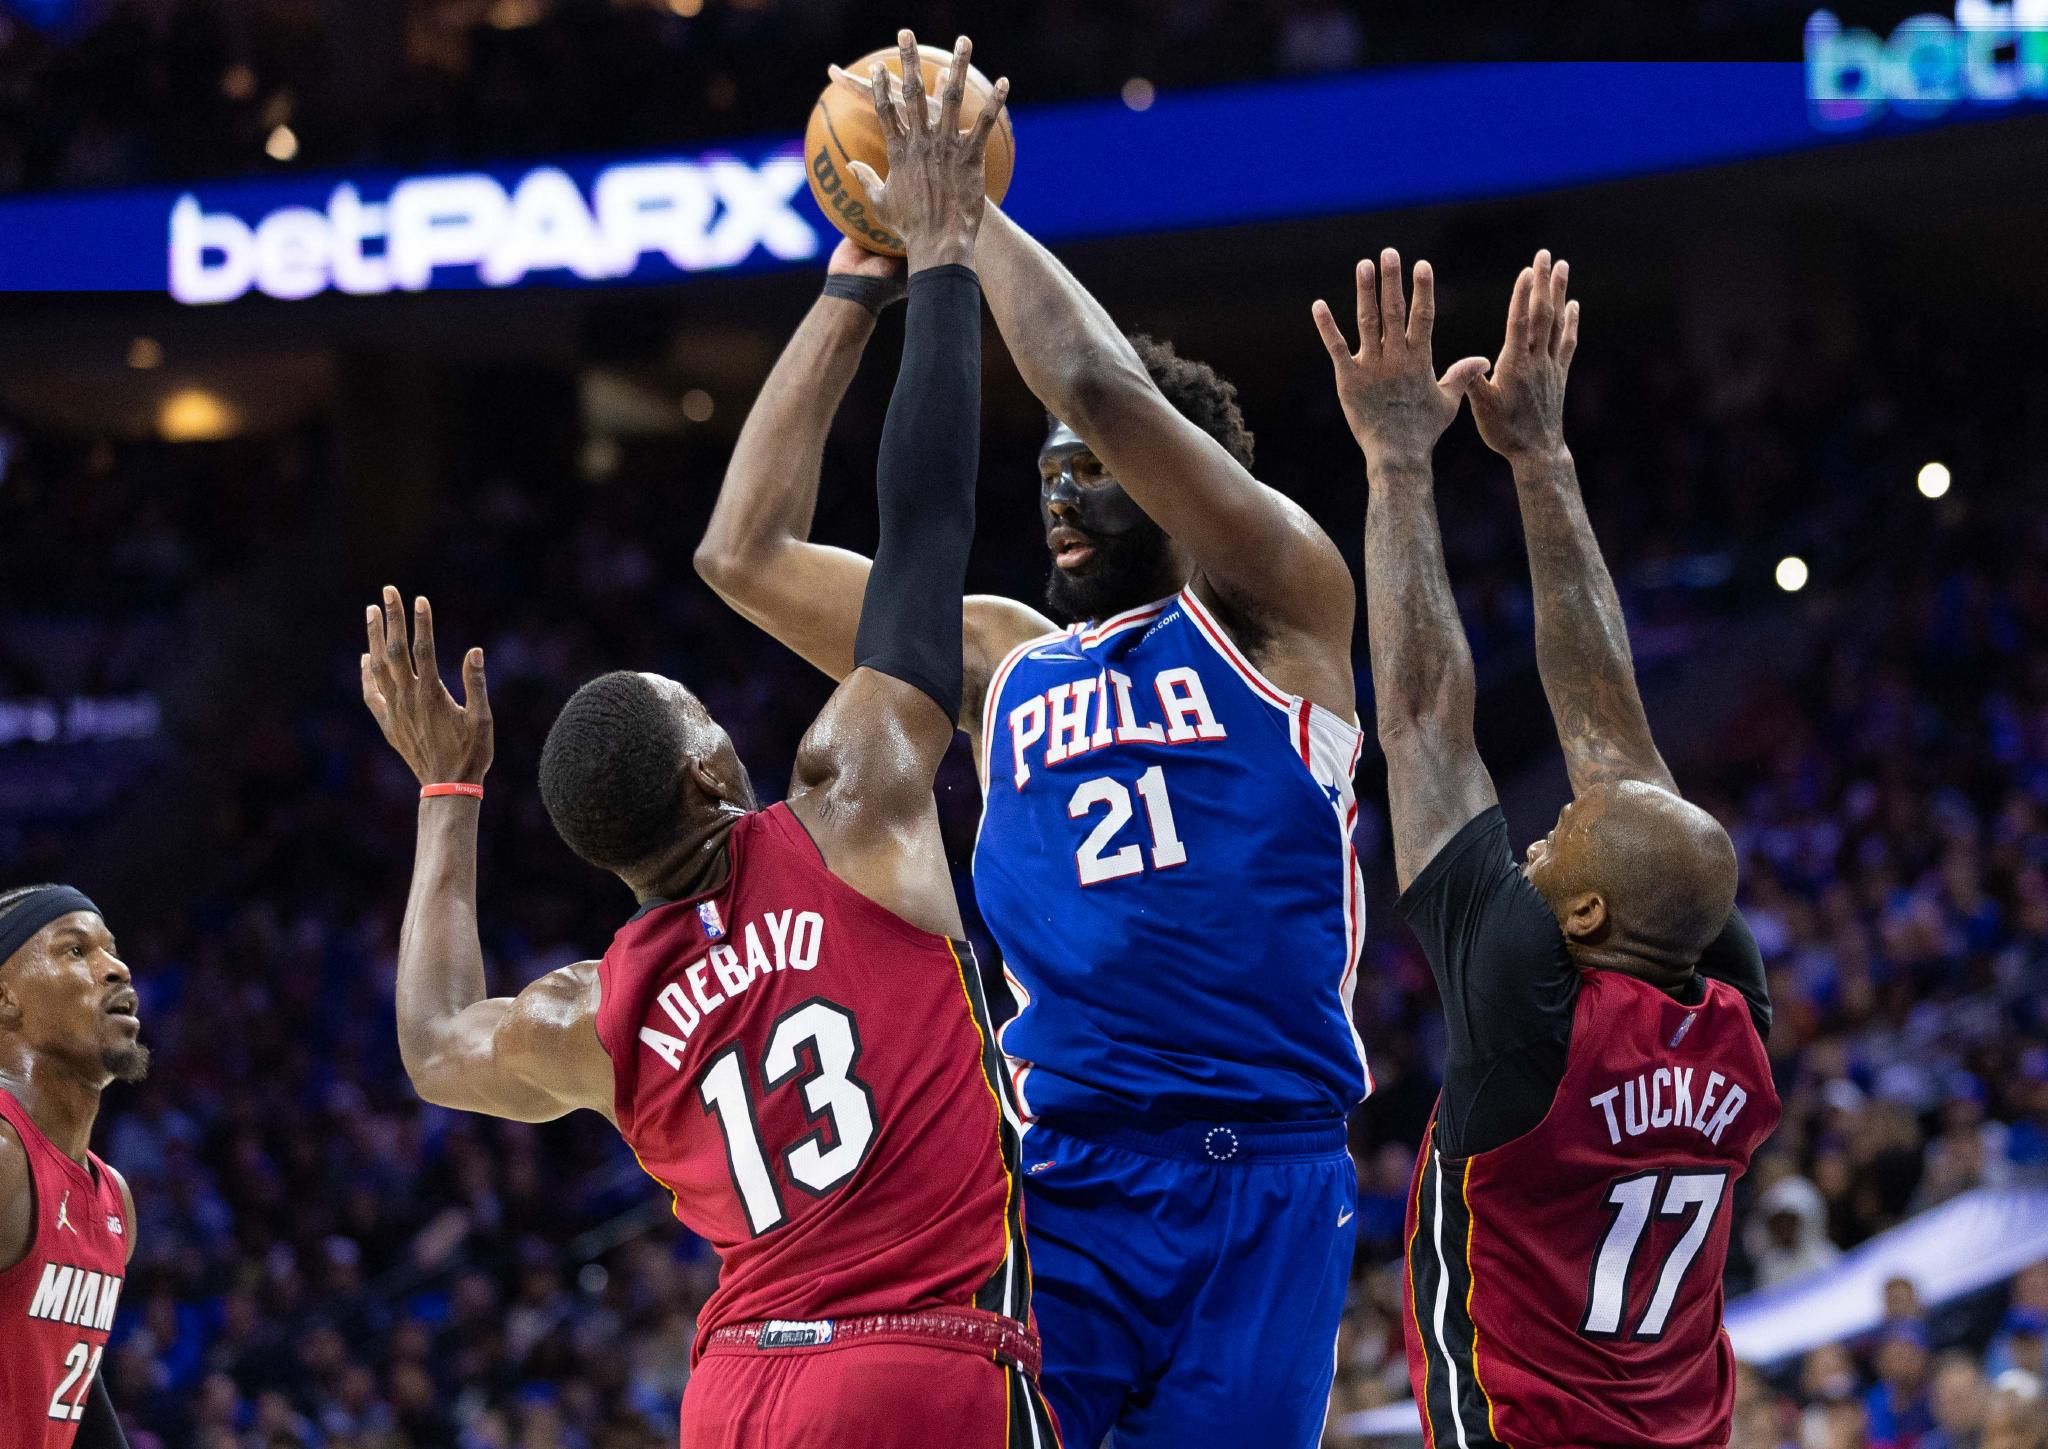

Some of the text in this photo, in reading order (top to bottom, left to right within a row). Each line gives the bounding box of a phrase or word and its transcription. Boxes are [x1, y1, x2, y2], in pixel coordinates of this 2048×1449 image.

[169, 154, 819, 305] betPARX
[813, 146, 905, 249] Wilson
[1008, 666, 1227, 792] PHILA
[1067, 766, 1187, 887] 21
[638, 909, 825, 1072] ADEBAYO
[698, 996, 880, 1238] 13
[1589, 1066, 1748, 1146] TUCKER
[28, 1261, 124, 1332] MIAM
[1577, 1166, 1731, 1343] 17
